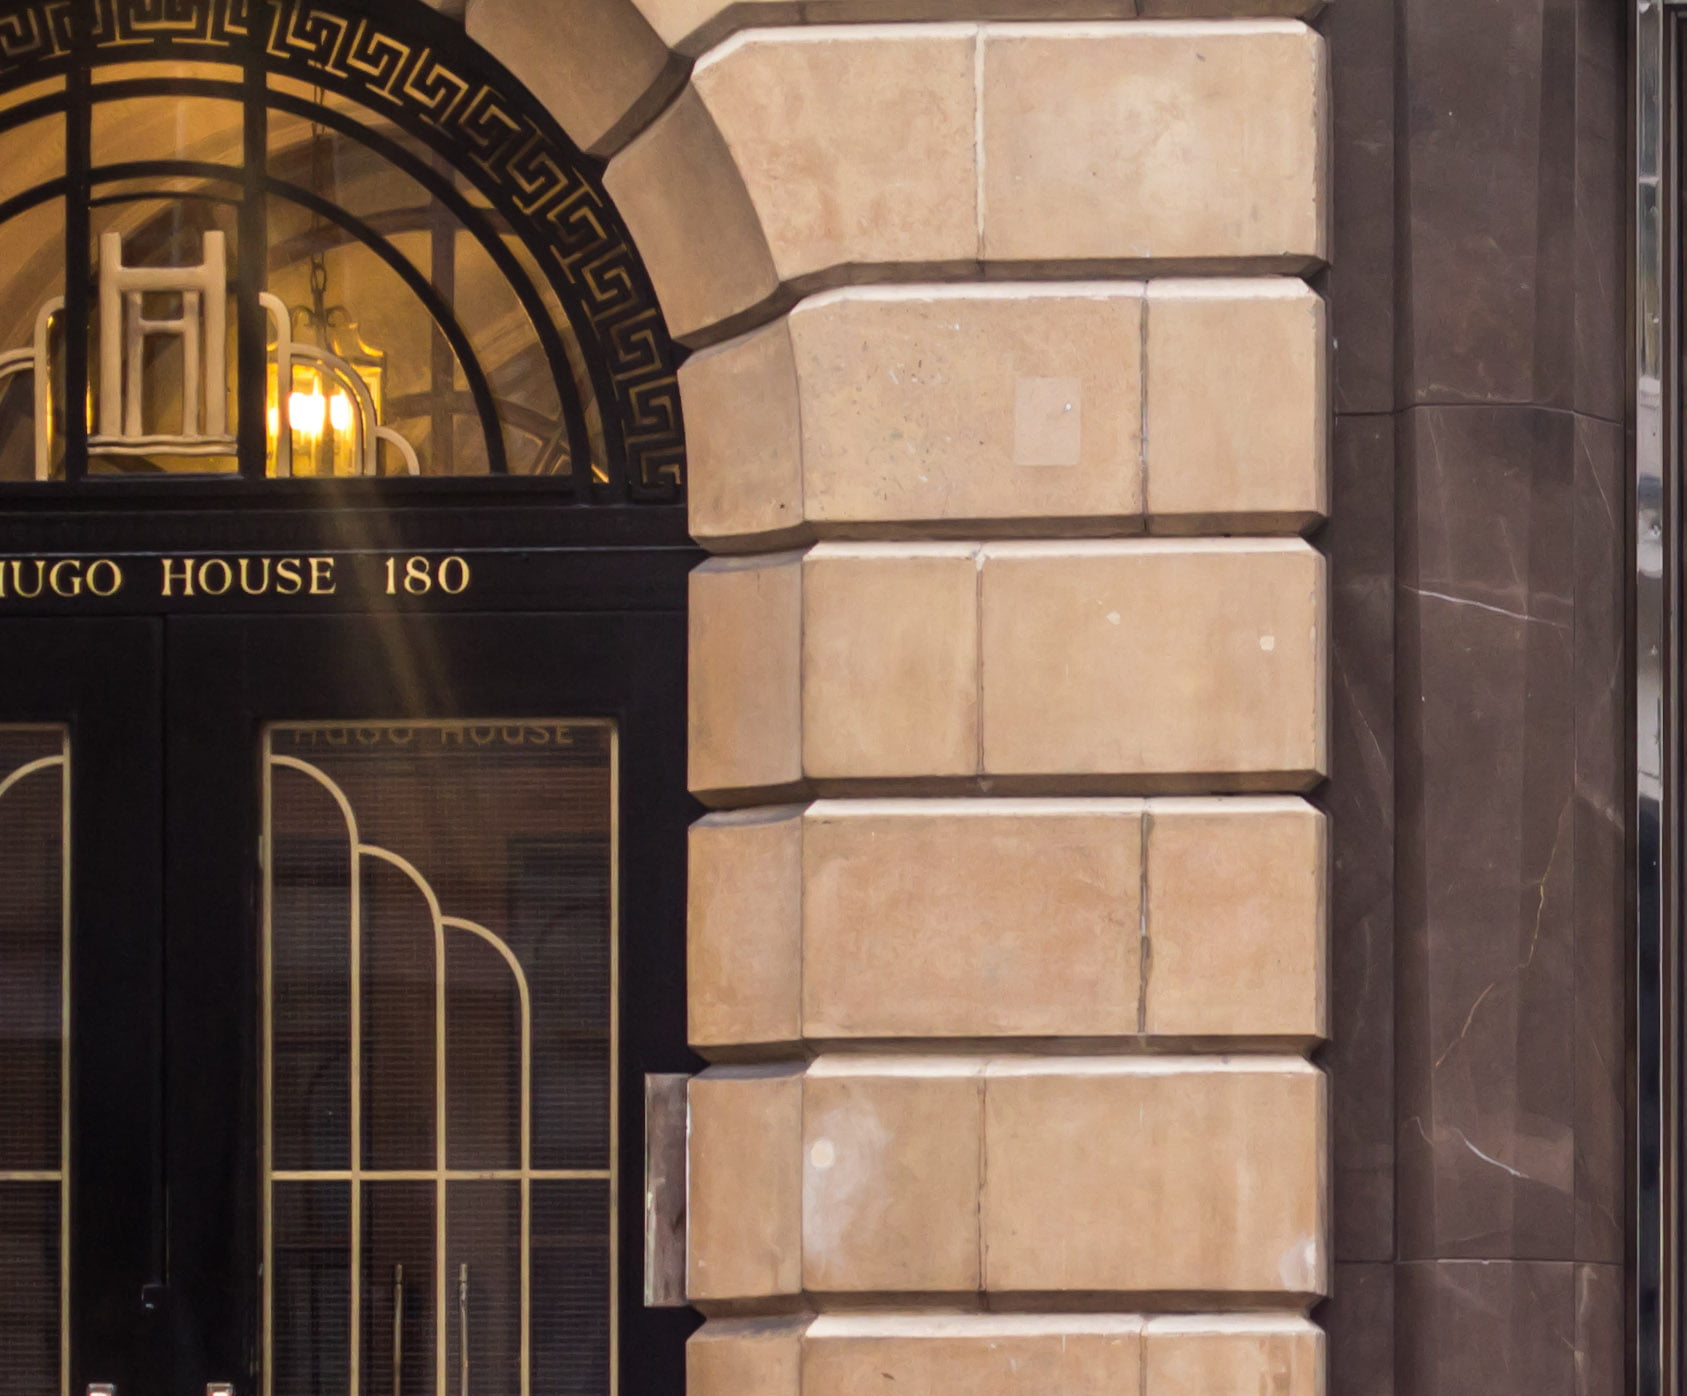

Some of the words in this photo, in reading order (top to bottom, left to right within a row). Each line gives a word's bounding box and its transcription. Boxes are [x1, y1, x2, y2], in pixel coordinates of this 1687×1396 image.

[0, 559, 122, 597] UGO
[161, 557, 336, 596] HOUSE
[385, 556, 470, 594] 180
